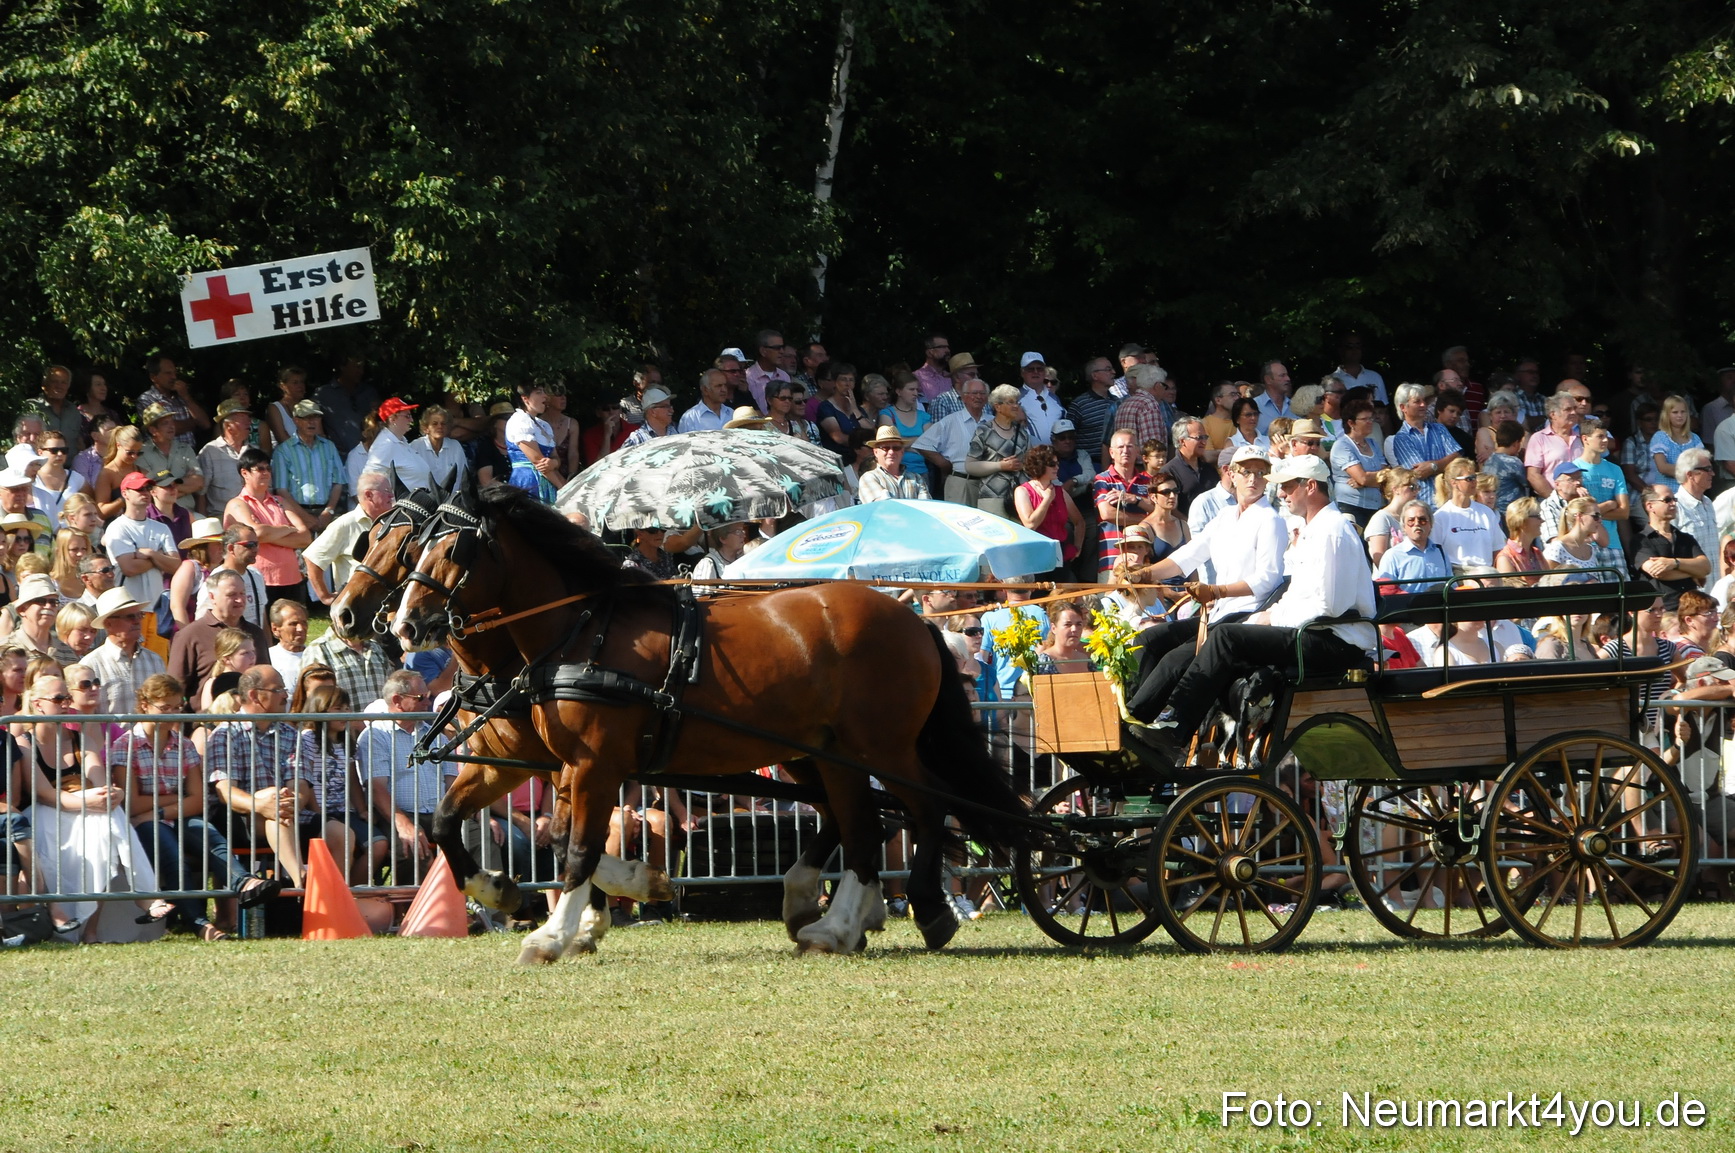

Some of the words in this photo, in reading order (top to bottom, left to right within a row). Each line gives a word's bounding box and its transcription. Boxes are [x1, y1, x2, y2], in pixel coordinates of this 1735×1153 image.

[259, 258, 365, 294] Erste
[271, 293, 367, 330] Hilfe
[918, 568, 961, 582] WOLKE
